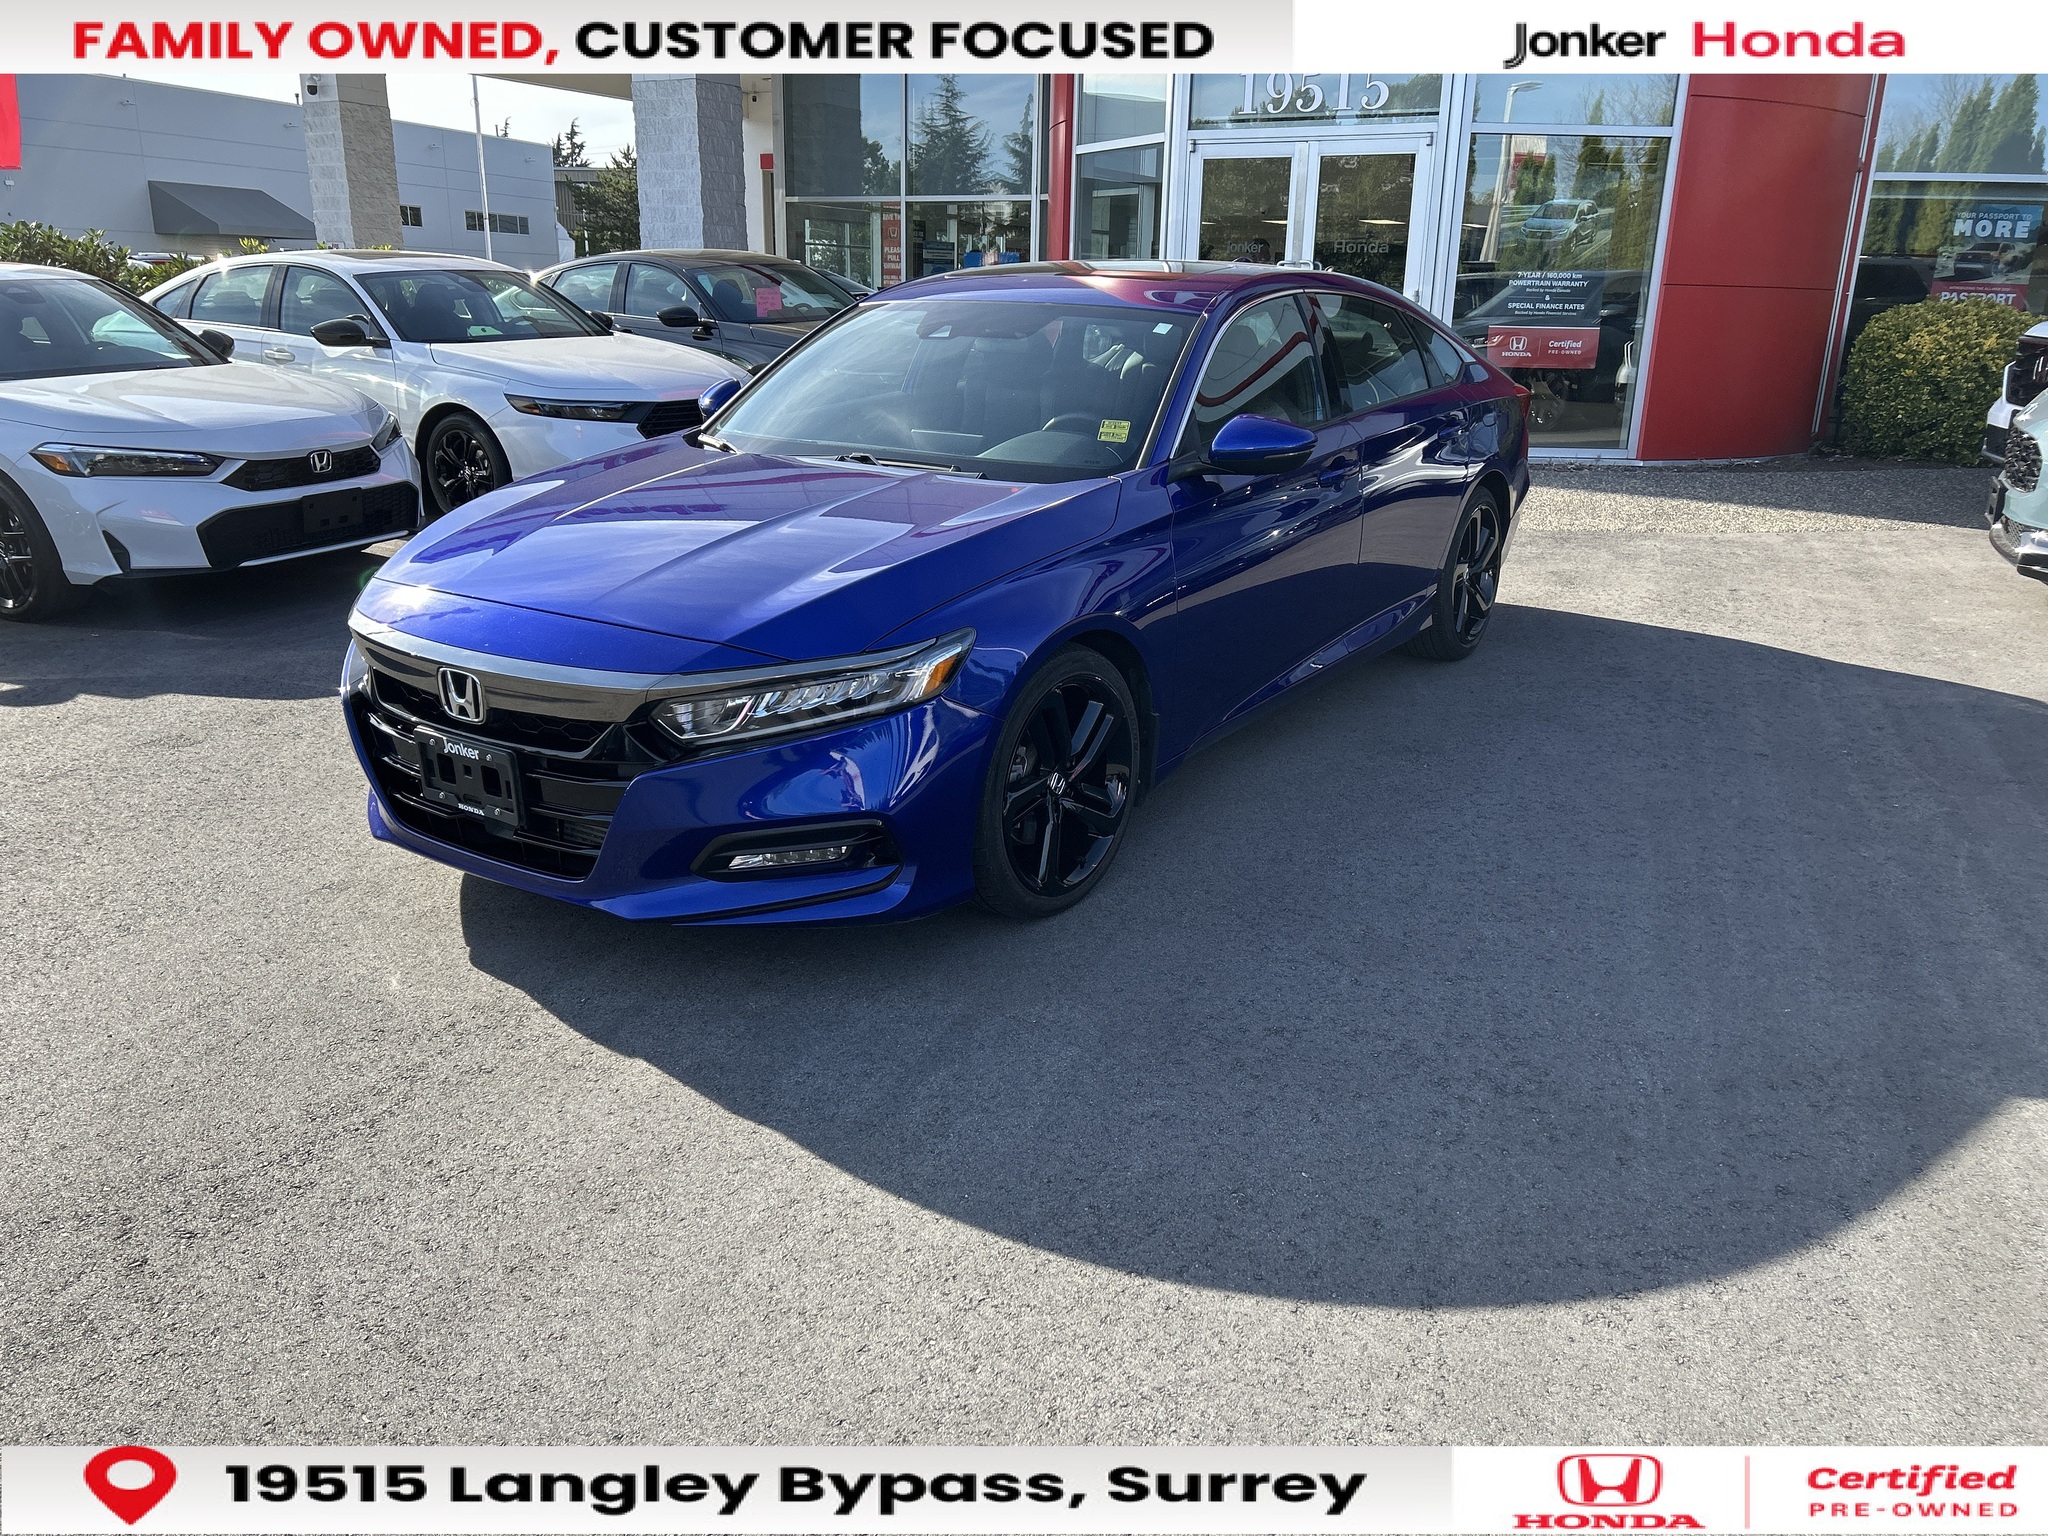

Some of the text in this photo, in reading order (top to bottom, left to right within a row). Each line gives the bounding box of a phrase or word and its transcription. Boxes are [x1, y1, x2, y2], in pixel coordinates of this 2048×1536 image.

[1238, 73, 1390, 115] 19515
[1956, 211, 2033, 221] YOUR PASSPORT TO
[1953, 219, 2031, 238] MORE
[1333, 239, 1390, 254] Honda
[1517, 271, 1541, 279] 7-YEAR
[1547, 272, 1571, 280] 160,000
[1508, 279, 1551, 287] POWERTRAIN
[1548, 340, 1582, 349] Certified
[443, 737, 480, 760] Jonker
[457, 803, 485, 816] HONDA
